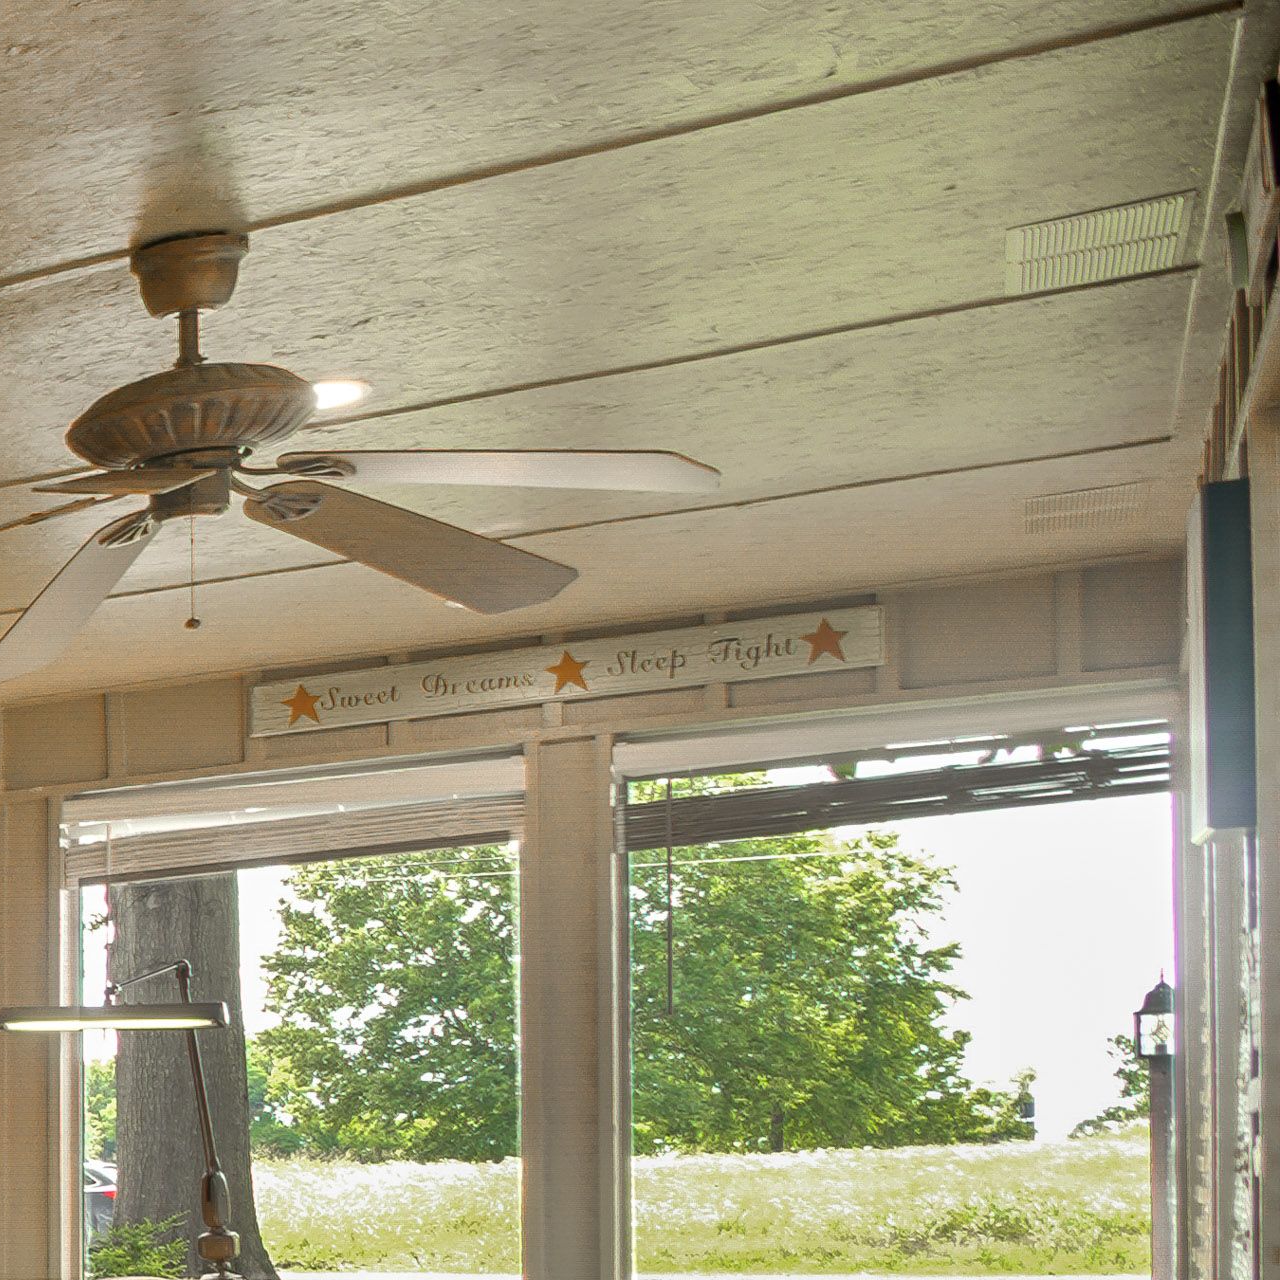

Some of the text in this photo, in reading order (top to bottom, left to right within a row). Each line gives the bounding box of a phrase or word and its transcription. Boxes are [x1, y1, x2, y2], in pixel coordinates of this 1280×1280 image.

[320, 633, 799, 711] Sweet Dreams Sleep Tight
